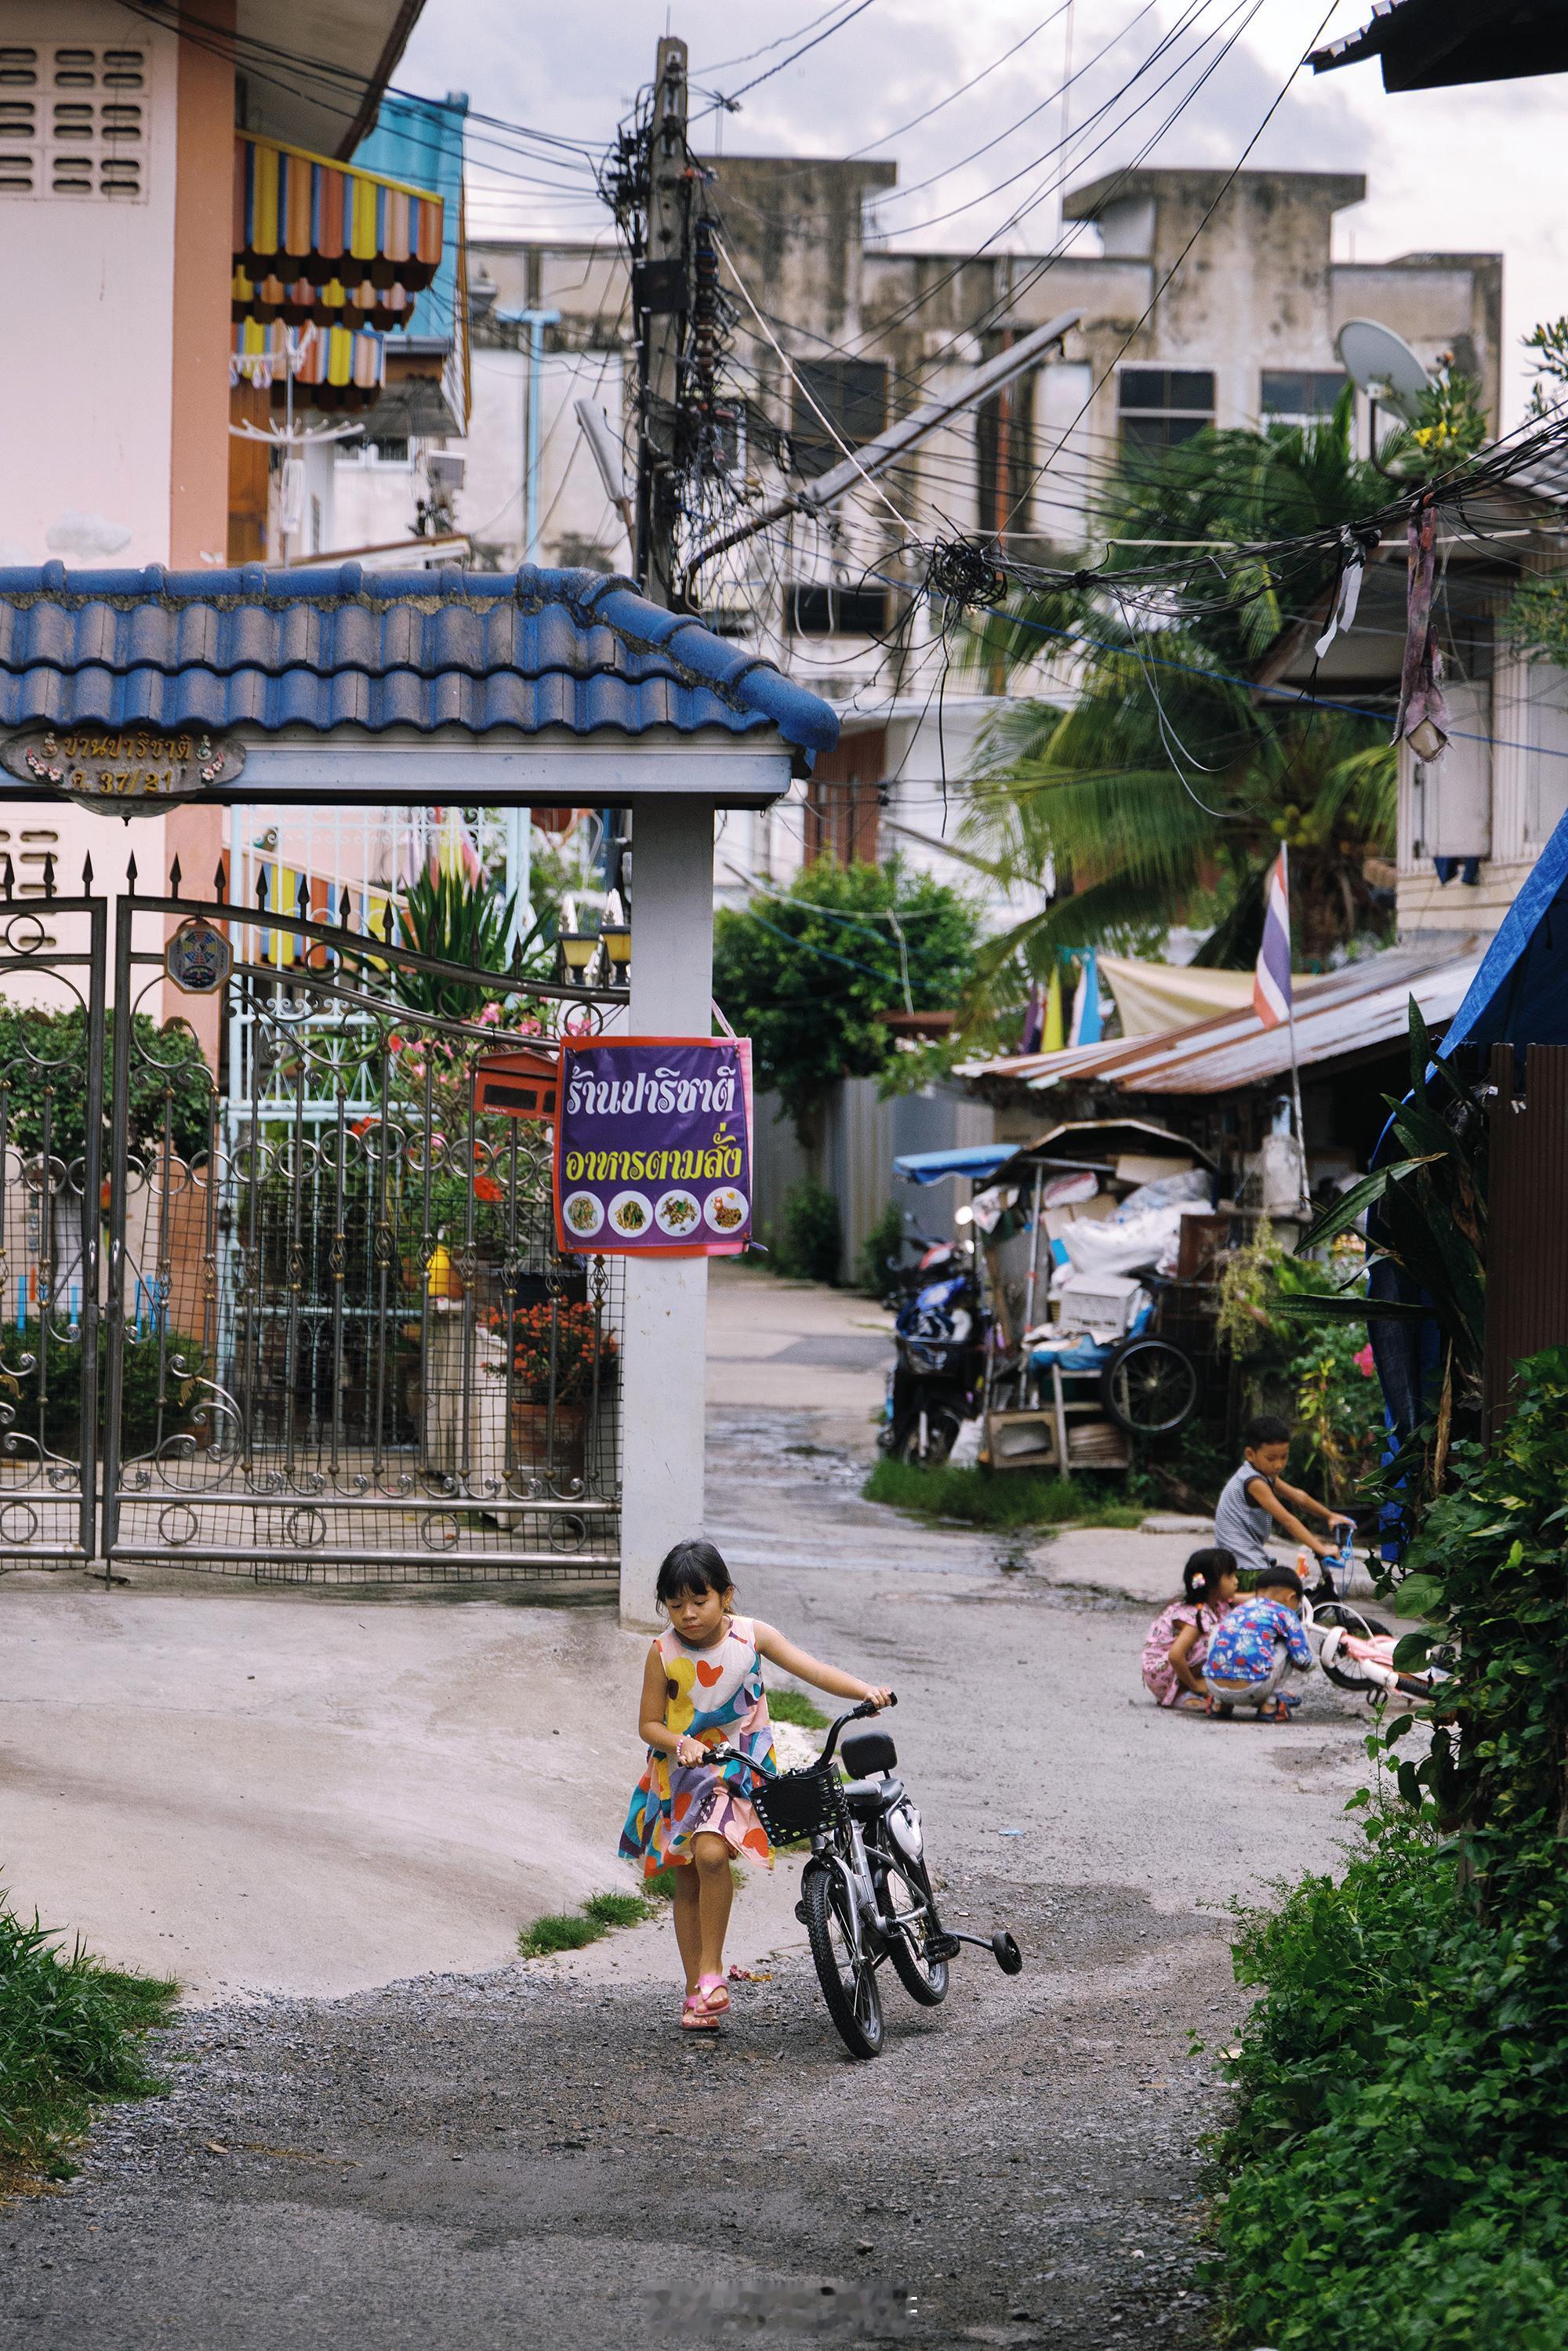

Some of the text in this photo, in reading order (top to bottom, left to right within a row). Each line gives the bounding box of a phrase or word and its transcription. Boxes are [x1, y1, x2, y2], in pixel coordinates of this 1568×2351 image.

[566, 1065, 736, 1115] ร้านปาริชาติ
[565, 1122, 742, 1181] อาหารตามสั่ง
